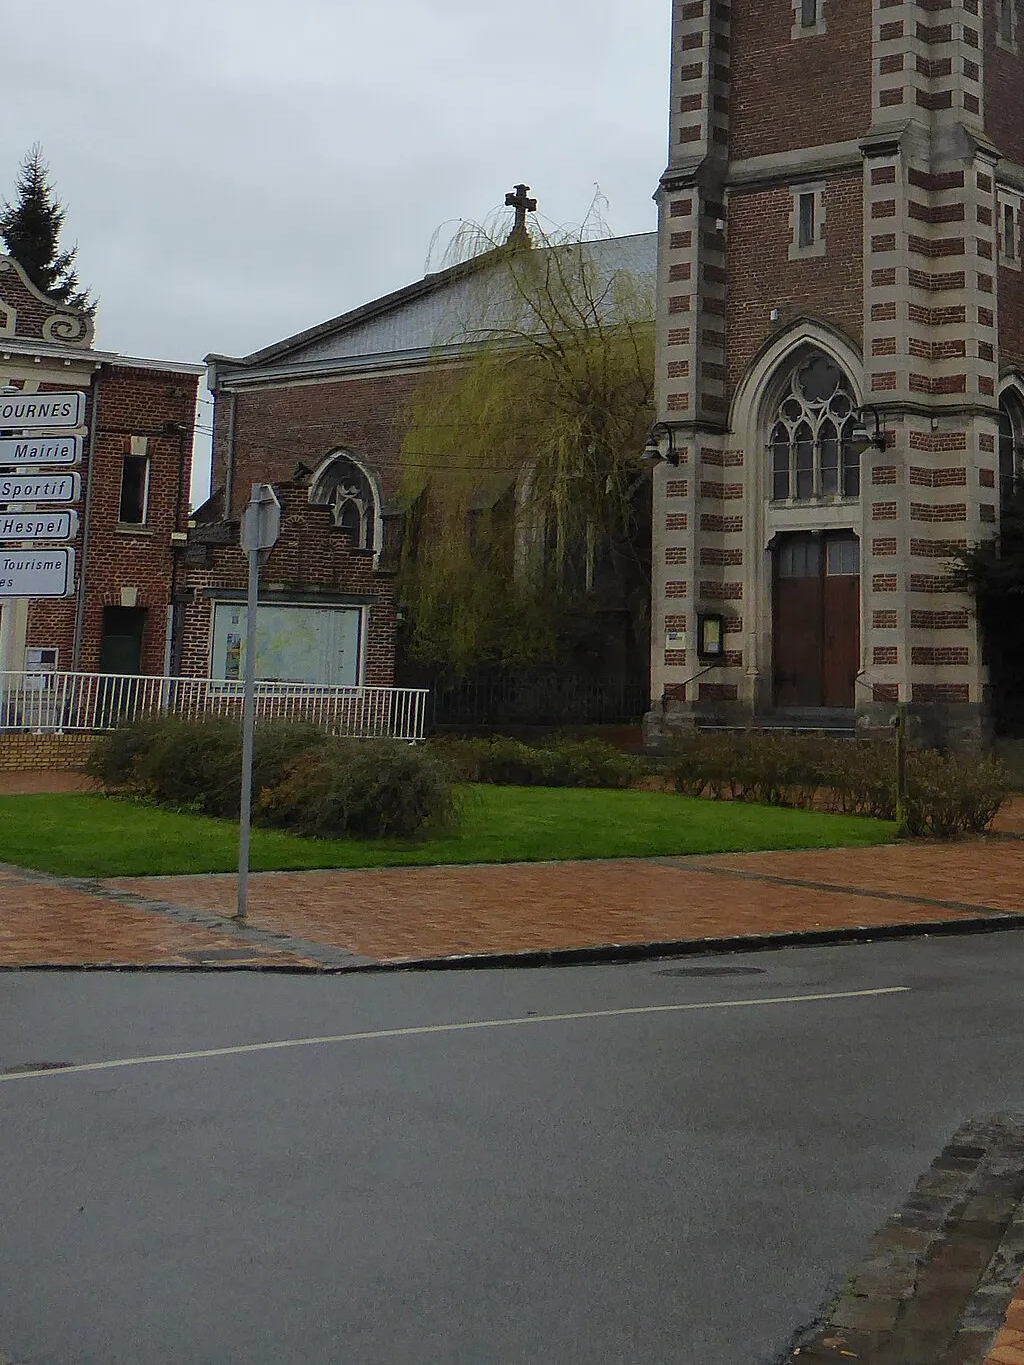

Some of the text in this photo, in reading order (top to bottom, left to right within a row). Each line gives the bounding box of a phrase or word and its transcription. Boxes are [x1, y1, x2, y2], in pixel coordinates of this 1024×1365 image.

[0, 403, 72, 418] OURNES
[14, 444, 69, 457] Mairie
[2, 481, 66, 498] Sportif
[4, 559, 62, 570] Tourisme
